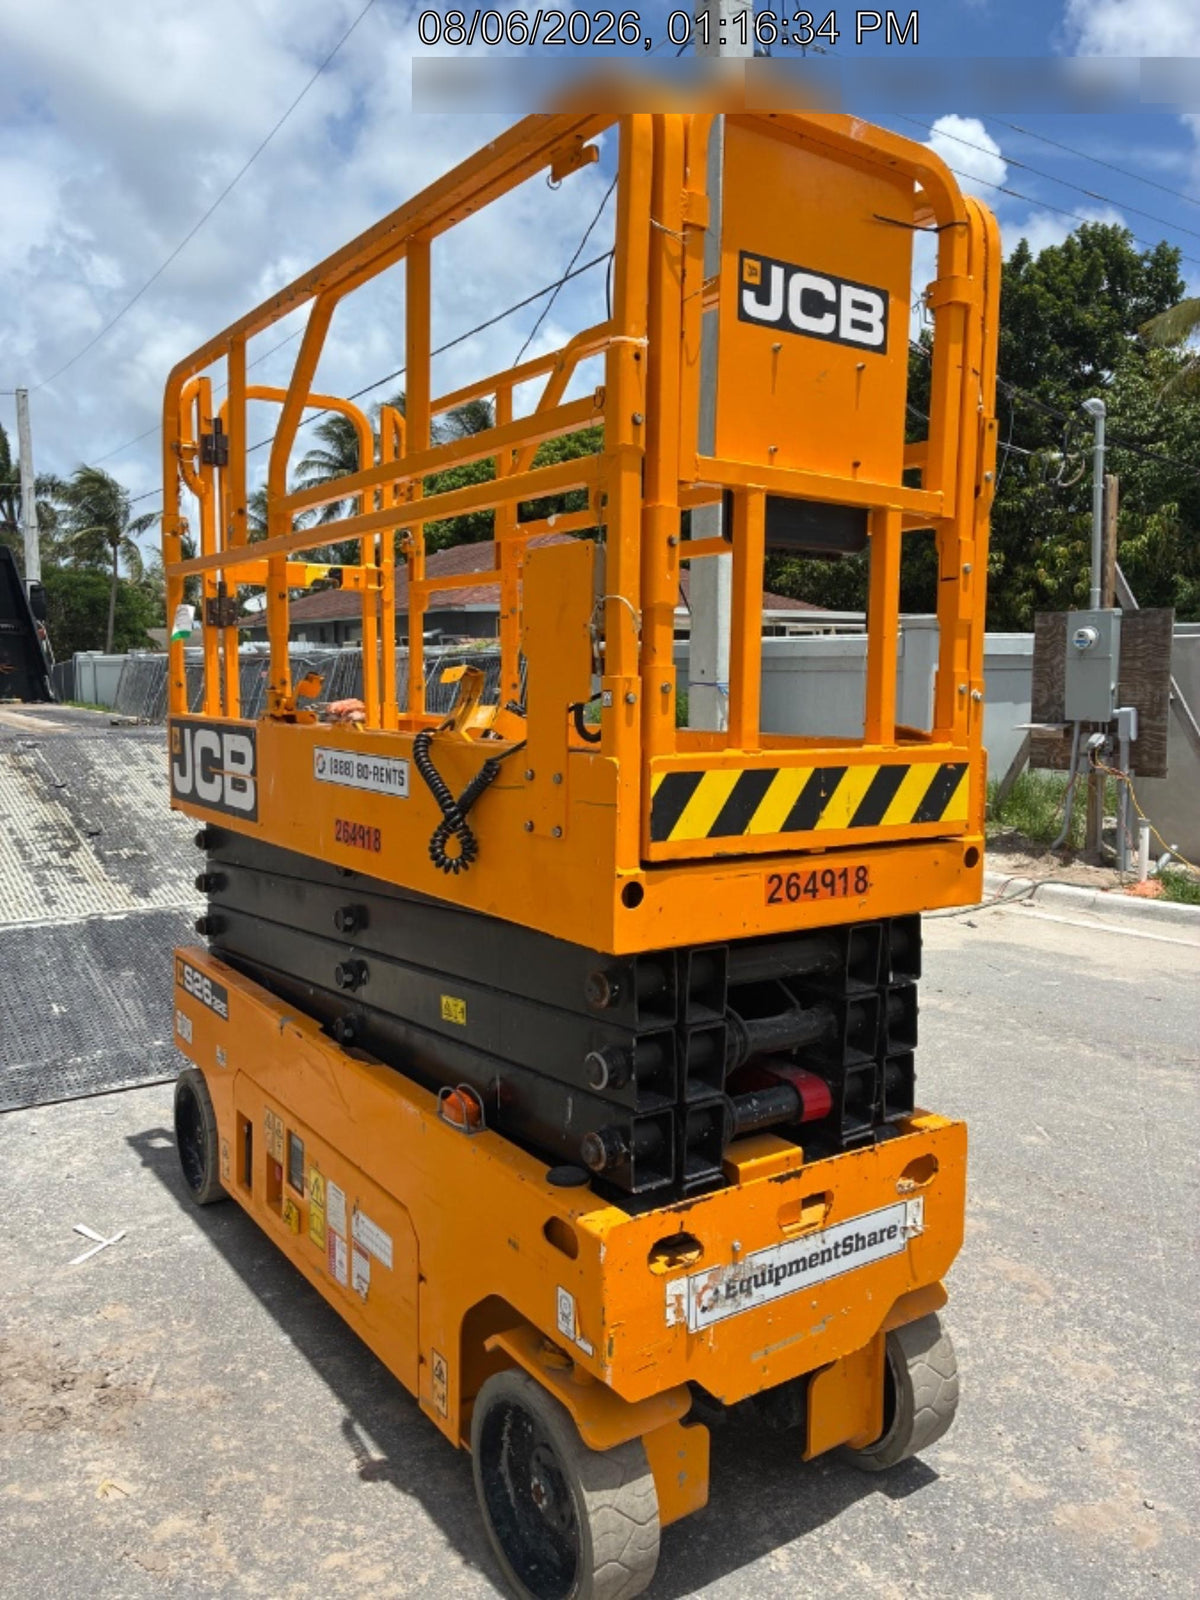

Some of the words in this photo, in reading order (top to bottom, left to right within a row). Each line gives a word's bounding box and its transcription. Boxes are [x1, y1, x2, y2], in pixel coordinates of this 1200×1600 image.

[743, 265, 884, 346] JCB
[172, 728, 256, 812] JCB
[356, 762, 406, 787] 80-RENTS
[335, 820, 382, 853] 264918
[767, 865, 869, 904] 264918
[725, 1223, 898, 1299] EquipmentShare
